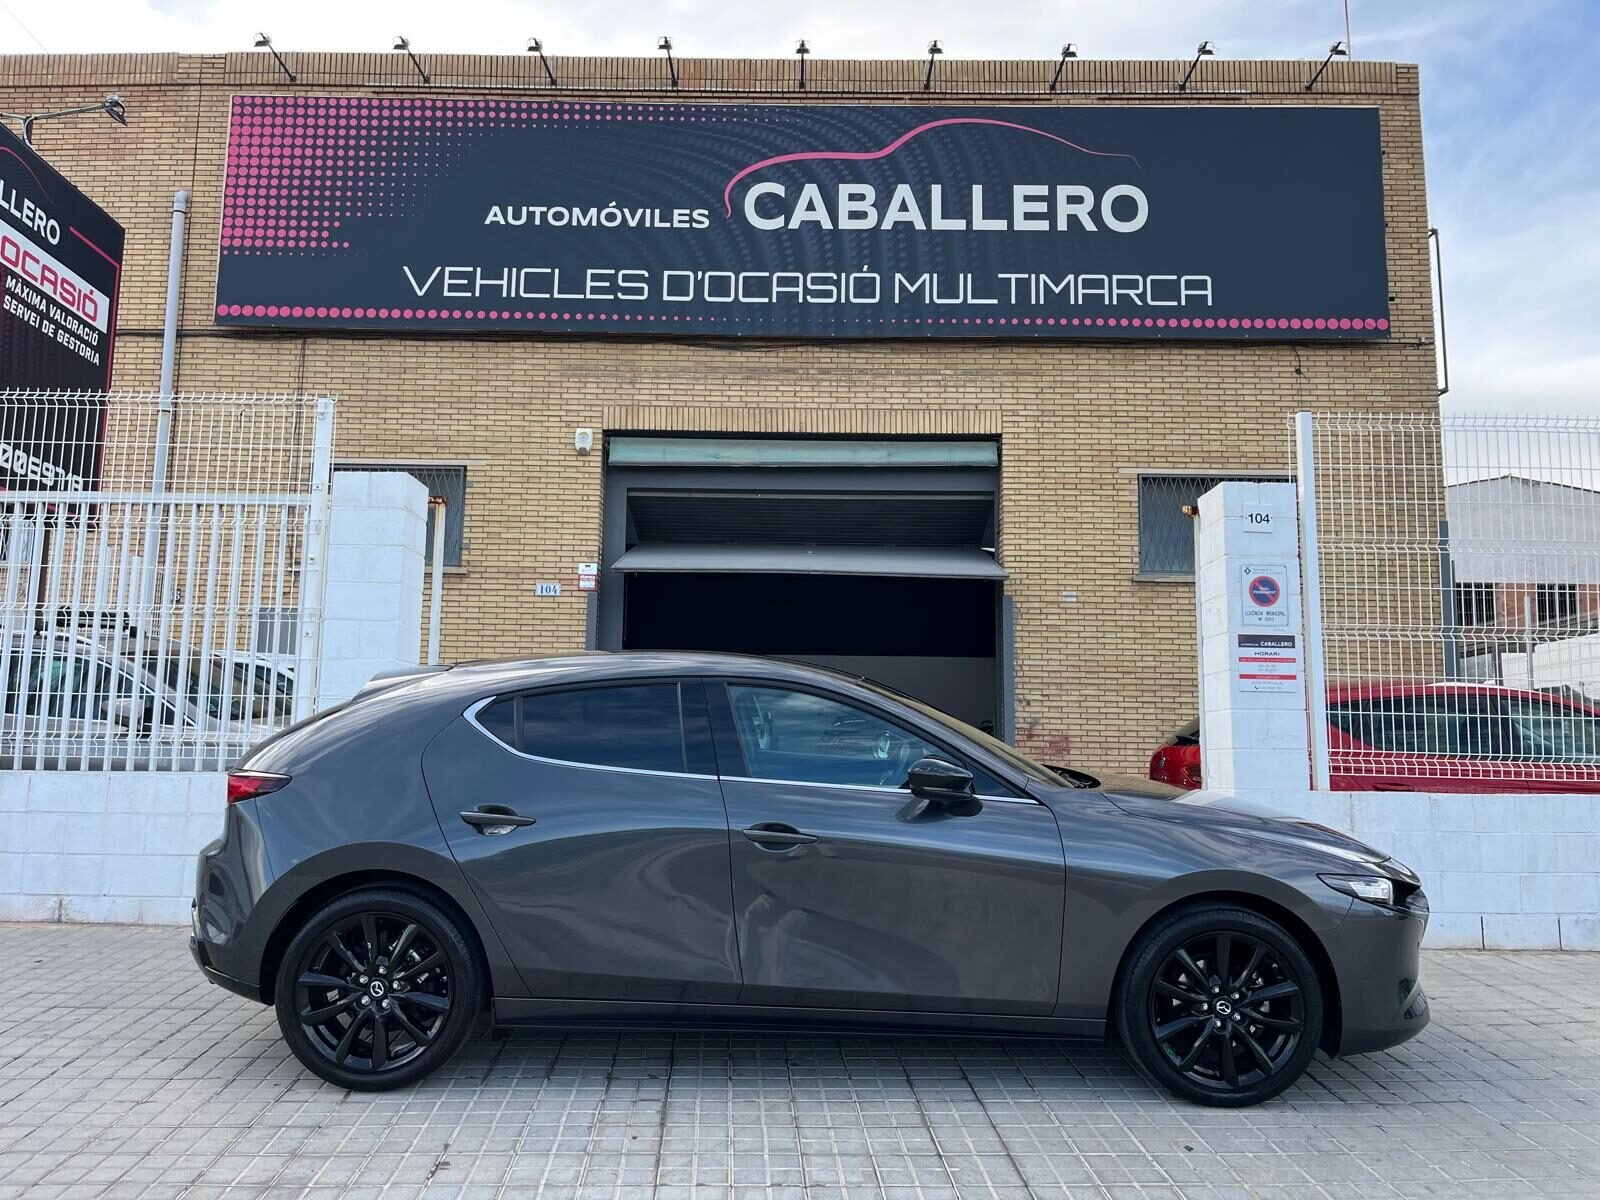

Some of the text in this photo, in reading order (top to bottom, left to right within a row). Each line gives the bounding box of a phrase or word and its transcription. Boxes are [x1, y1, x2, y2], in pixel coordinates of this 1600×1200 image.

[484, 182, 1149, 233] AUTOMÓVILES CABALLERO
[1, 235, 98, 322] OCASIÓ
[403, 264, 1213, 307] VEHICLES D'OCASIÓ MULTIMARCA
[3, 294, 100, 367] SERVEI DE GESTORIA
[5, 275, 99, 346] MÀXIMA VALORACIÓ
[1248, 512, 1271, 524] 104
[540, 585, 557, 595] 104
